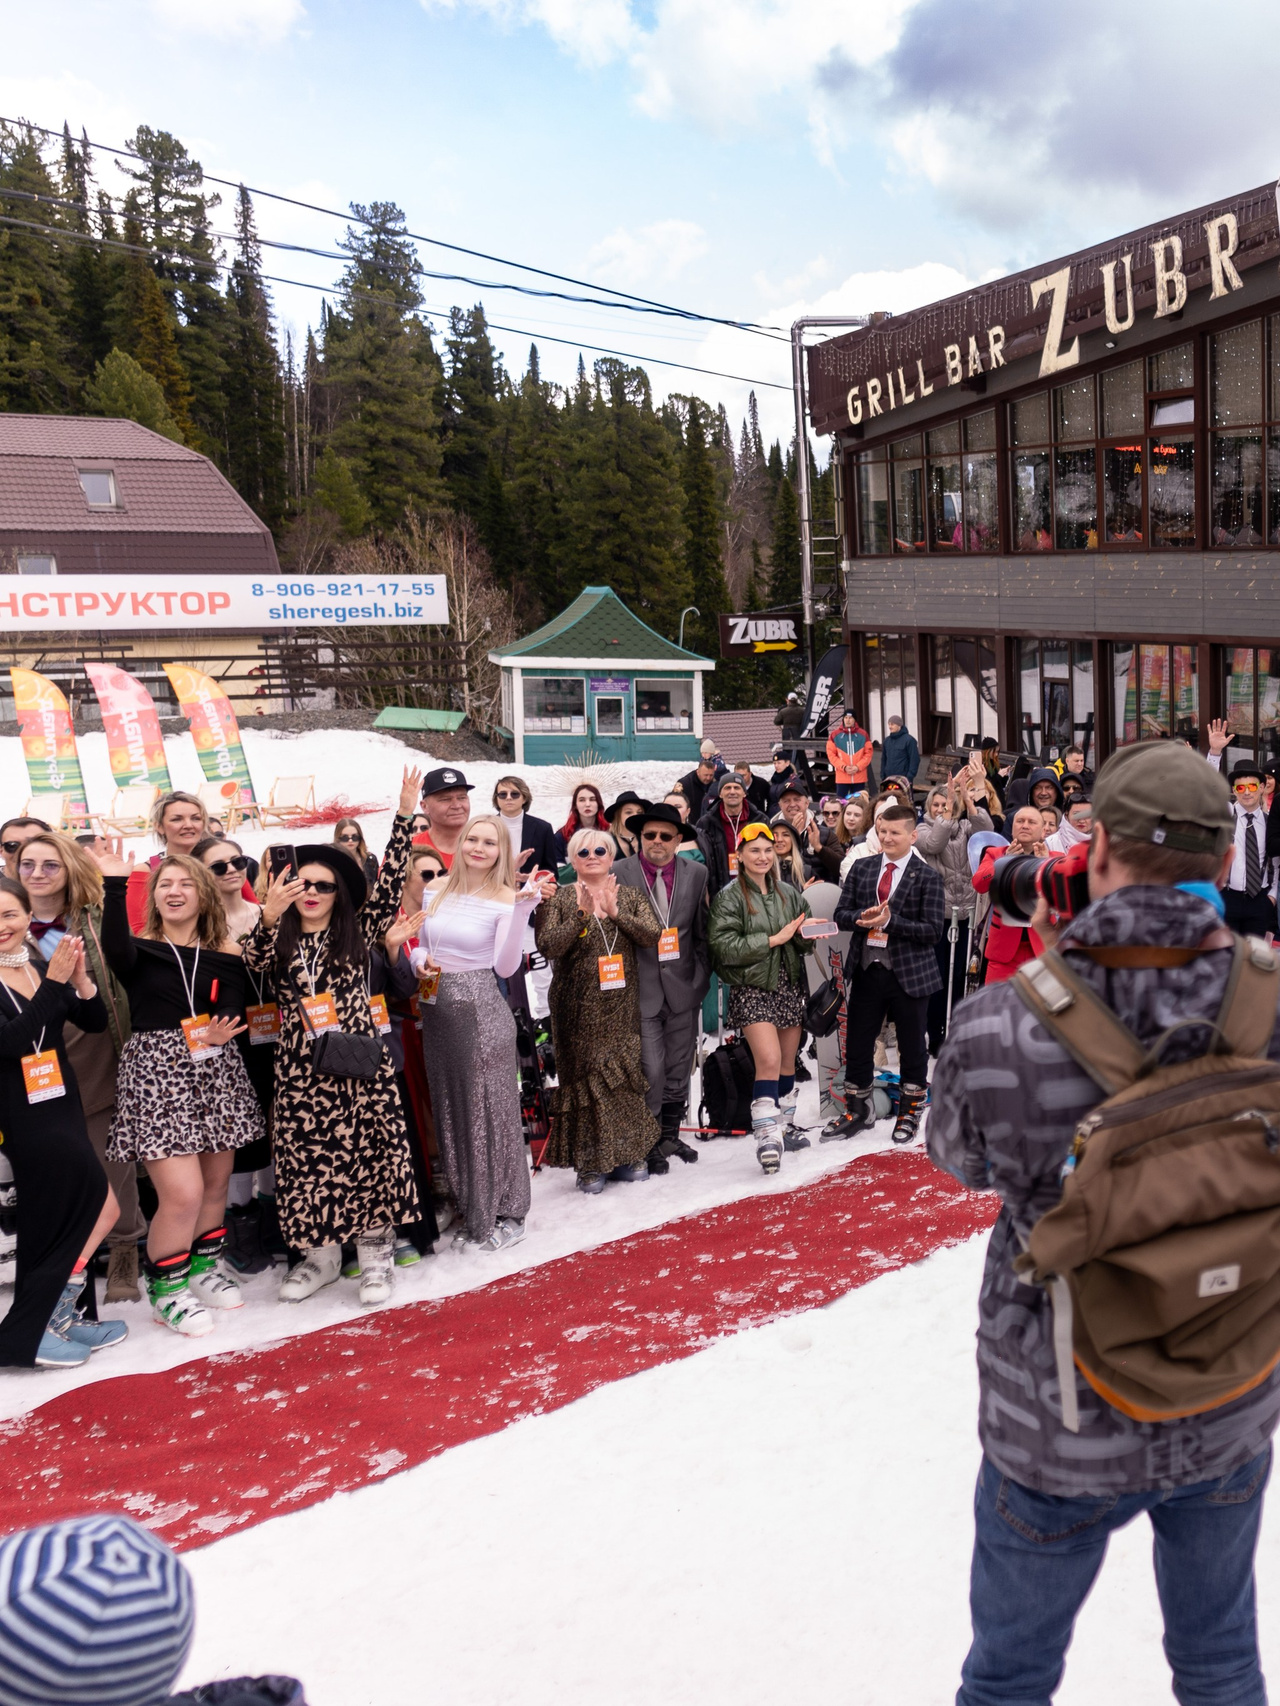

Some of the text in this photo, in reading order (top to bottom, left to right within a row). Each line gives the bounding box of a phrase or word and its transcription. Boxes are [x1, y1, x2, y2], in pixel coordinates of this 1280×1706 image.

[1030, 213, 1244, 378] ZUBR
[847, 325, 1008, 424] GRILL BAR
[252, 583, 435, 597] 8-906-921-17-55
[0, 591, 231, 618] НСТРУКТОР
[269, 602, 424, 623] sheregesh.biz
[729, 617, 798, 644] ZUBR
